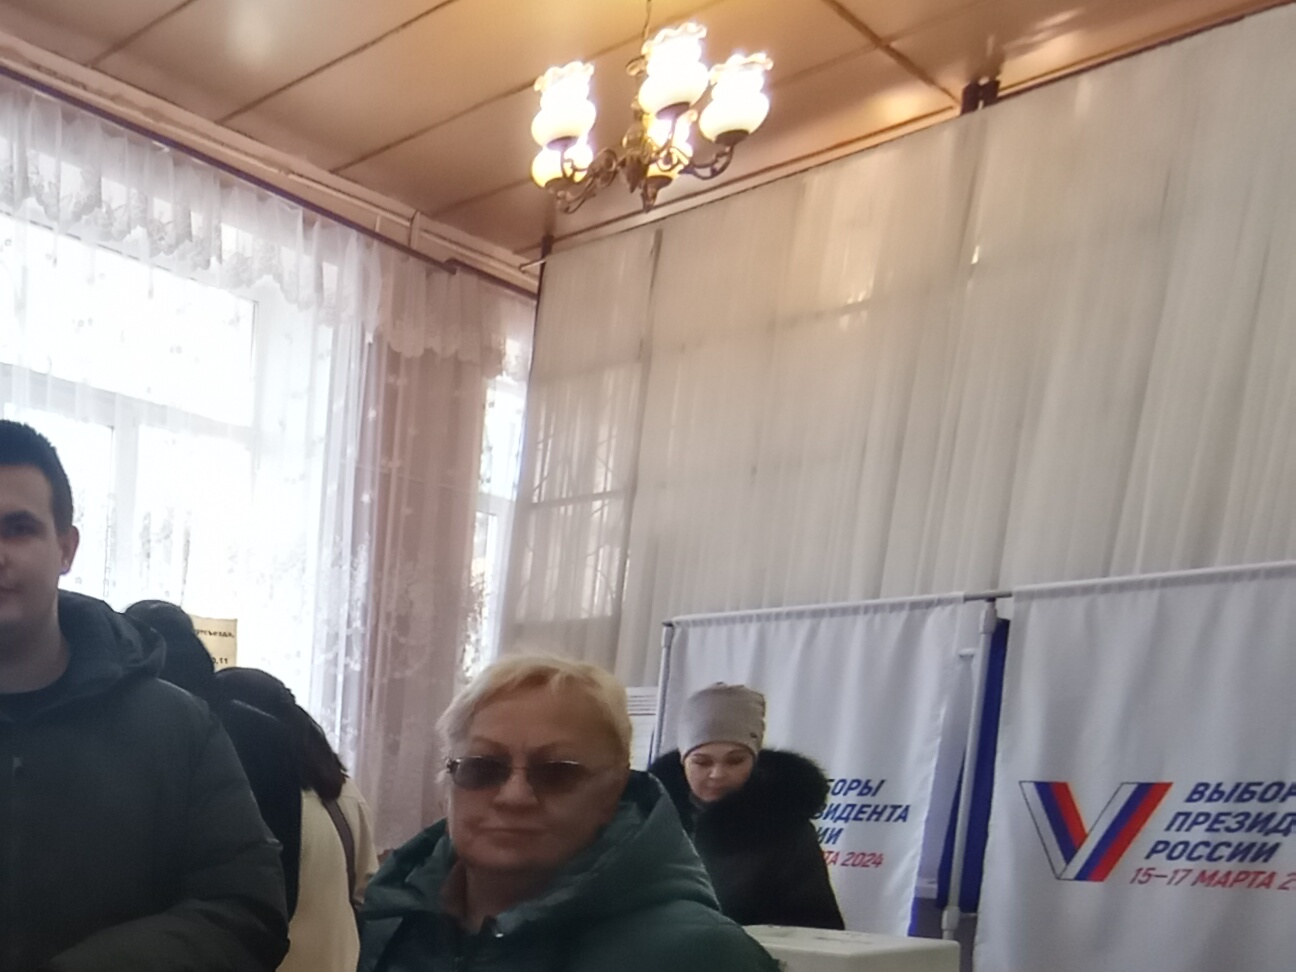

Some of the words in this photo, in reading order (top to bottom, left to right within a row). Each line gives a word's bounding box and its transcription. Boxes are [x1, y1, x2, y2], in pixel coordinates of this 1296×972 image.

[827, 779, 886, 797] ОРЫ
[840, 851, 884, 868] 2024
[1144, 840, 1282, 863] РОССИИ
[1190, 869, 1277, 889] МАРТА
